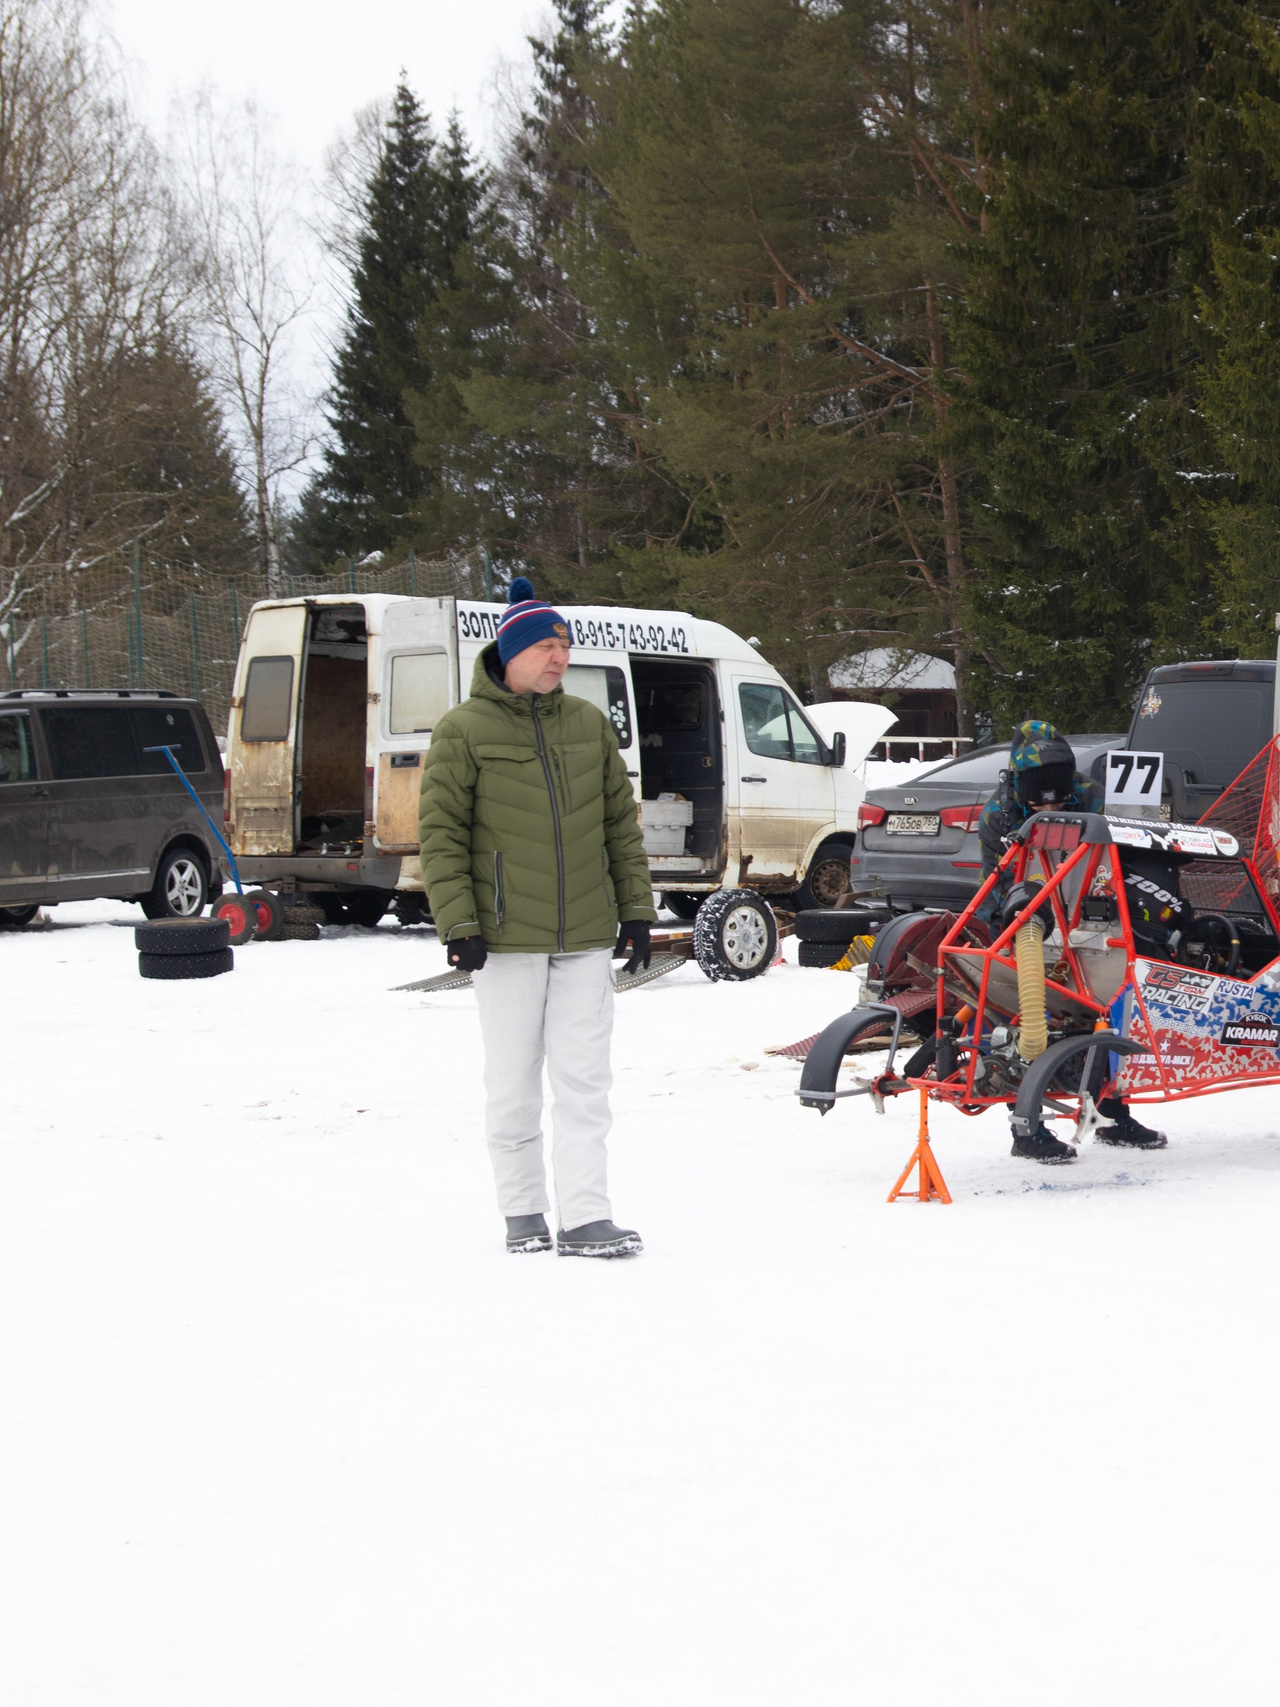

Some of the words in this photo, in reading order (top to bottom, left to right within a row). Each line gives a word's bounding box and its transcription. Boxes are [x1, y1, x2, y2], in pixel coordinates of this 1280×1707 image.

[458, 610, 501, 639] ЗОПЕ
[575, 619, 689, 653] 8-915-743-92-42
[1111, 755, 1160, 794] 77
[1124, 873, 1183, 913] 100%
[1145, 965, 1186, 988] GS
[1141, 986, 1208, 1011] RACING
[1177, 984, 1206, 995] TEAM
[1216, 980, 1255, 998] RUSTA
[1148, 1013, 1209, 1038] hop.at-racing.ru
[1245, 1014, 1268, 1024] КУБОК
[1225, 1026, 1279, 1042] KRAMAR
